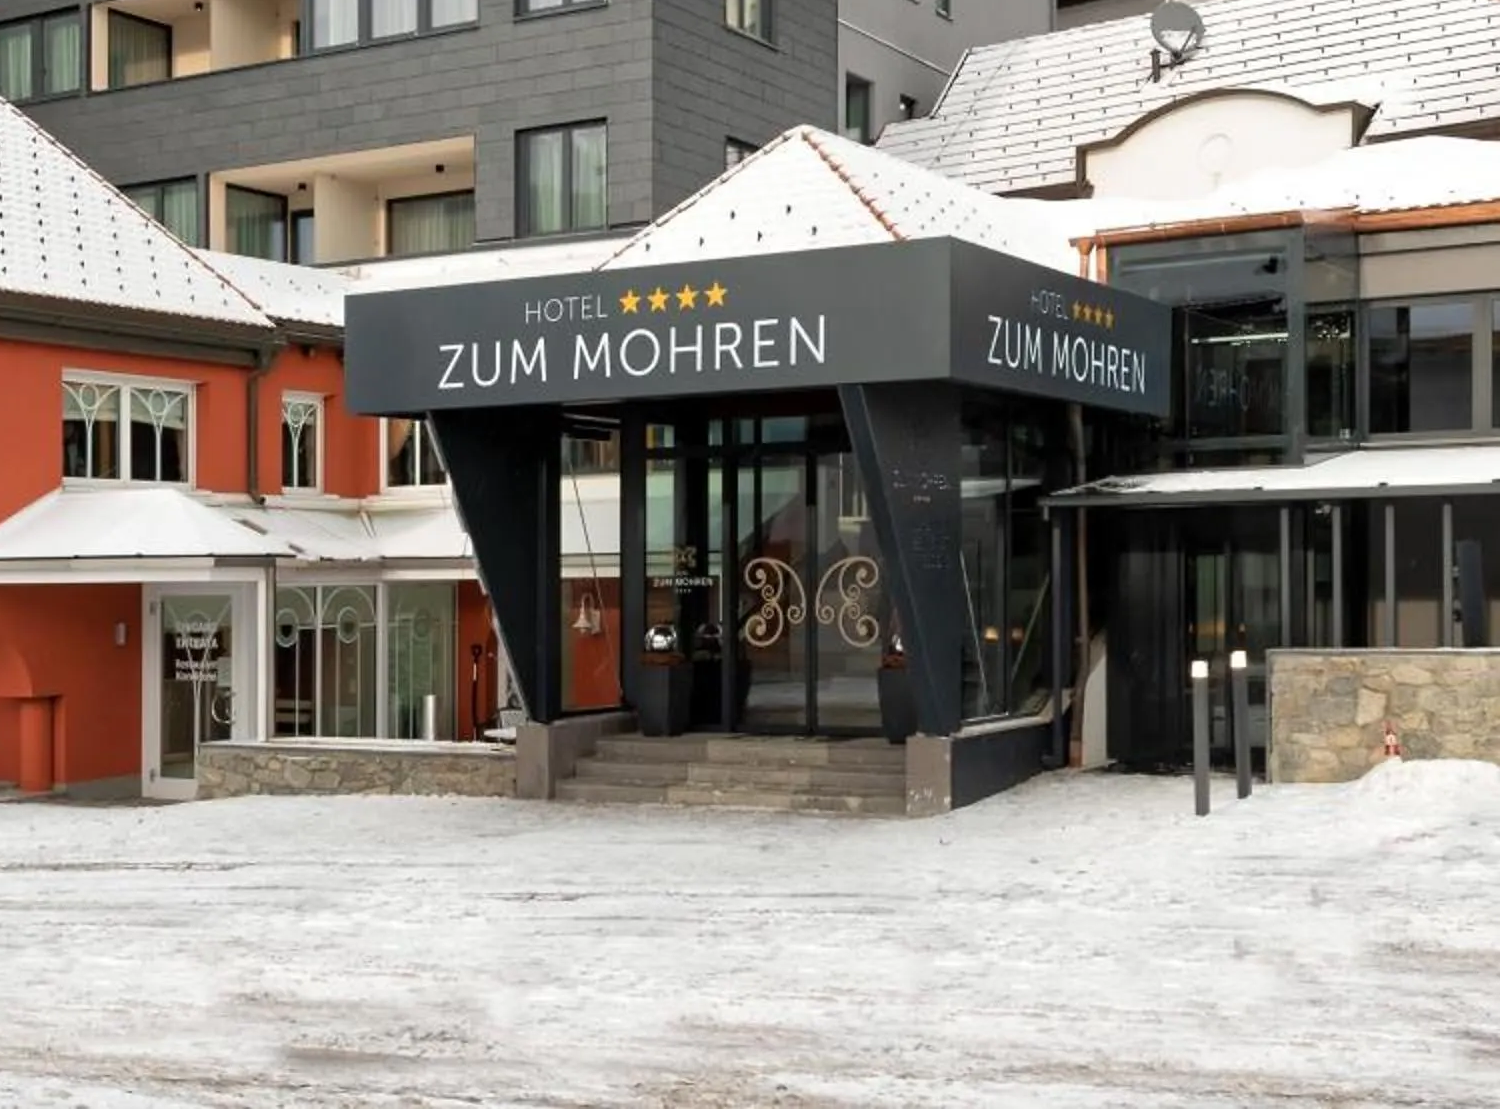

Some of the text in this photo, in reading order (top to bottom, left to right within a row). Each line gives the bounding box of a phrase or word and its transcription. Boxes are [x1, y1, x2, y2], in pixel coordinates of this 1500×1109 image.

[524, 295, 608, 325] HOTEL
[1031, 289, 1070, 320] HOTEL
[436, 314, 826, 390] ZUM MOHREN
[987, 314, 1043, 375] ZUM
[1051, 330, 1146, 395] MOHREN
